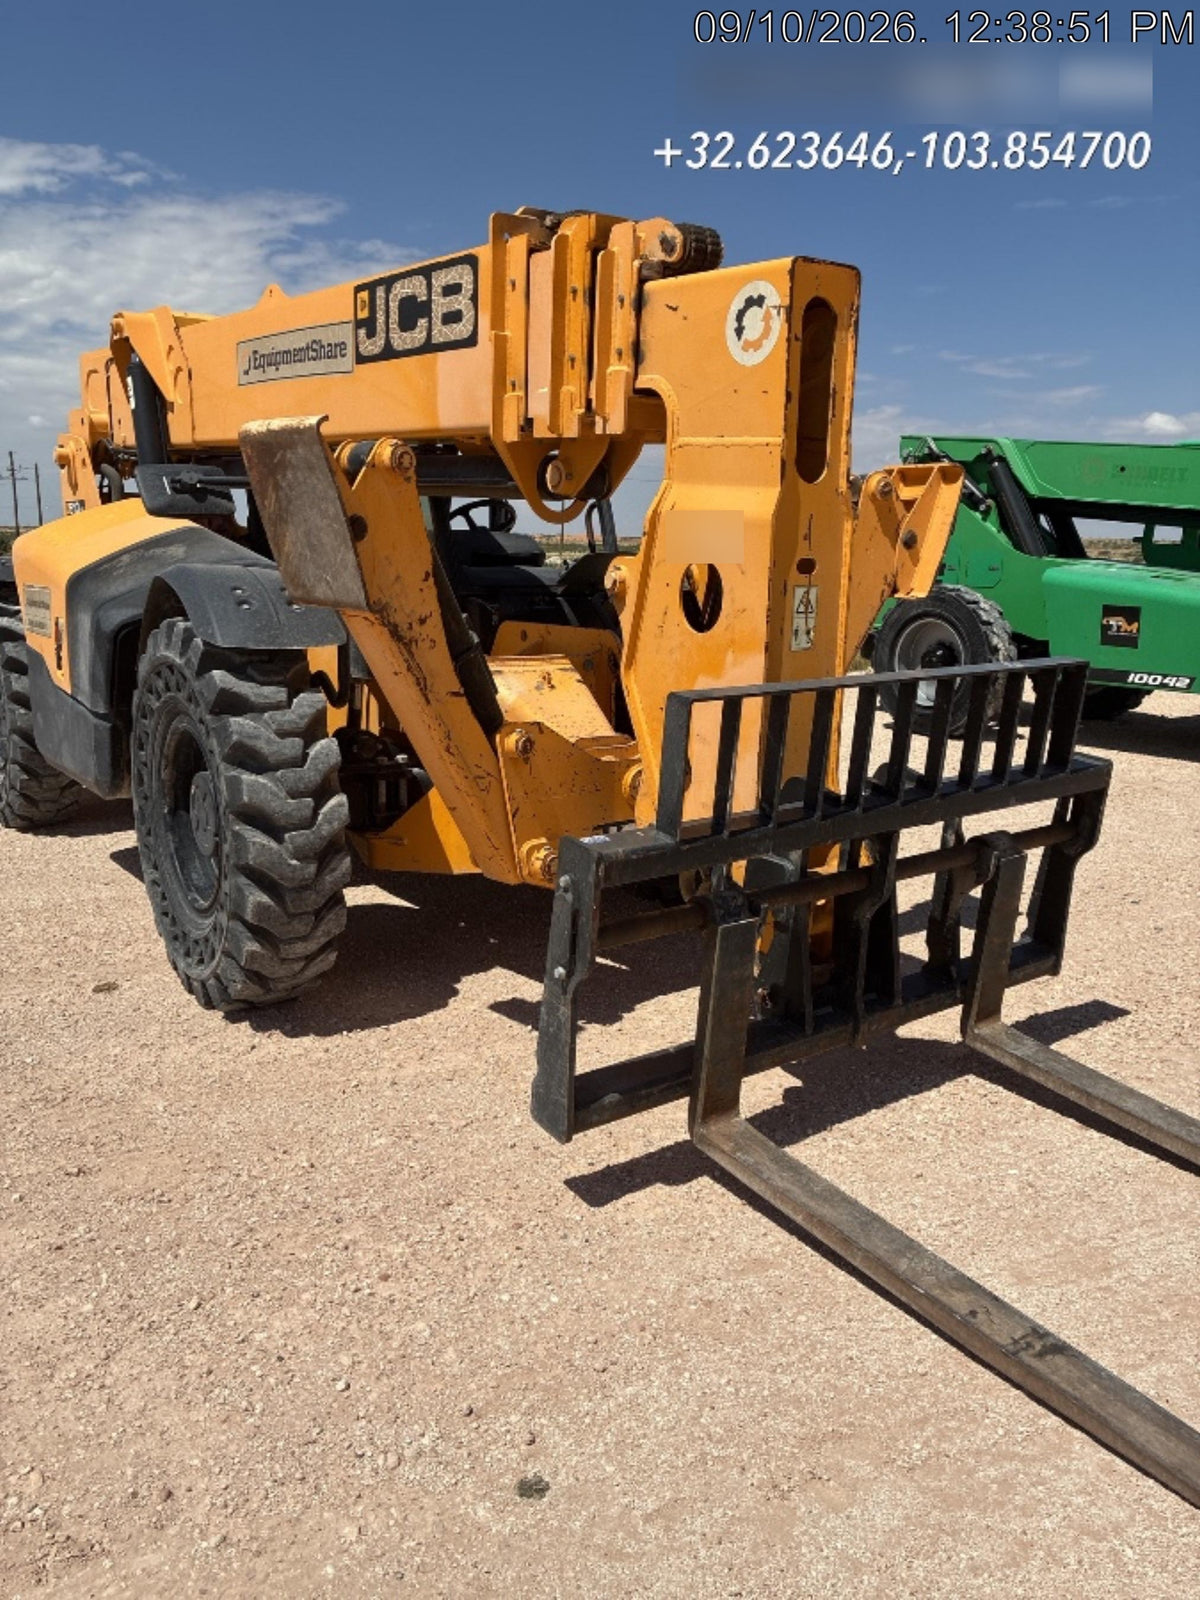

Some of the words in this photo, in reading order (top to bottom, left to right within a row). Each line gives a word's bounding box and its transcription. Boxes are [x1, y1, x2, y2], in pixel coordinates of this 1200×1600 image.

[358, 264, 475, 357] JCB
[252, 339, 348, 374] EquipmentShare
[1127, 673, 1190, 688] 10042
